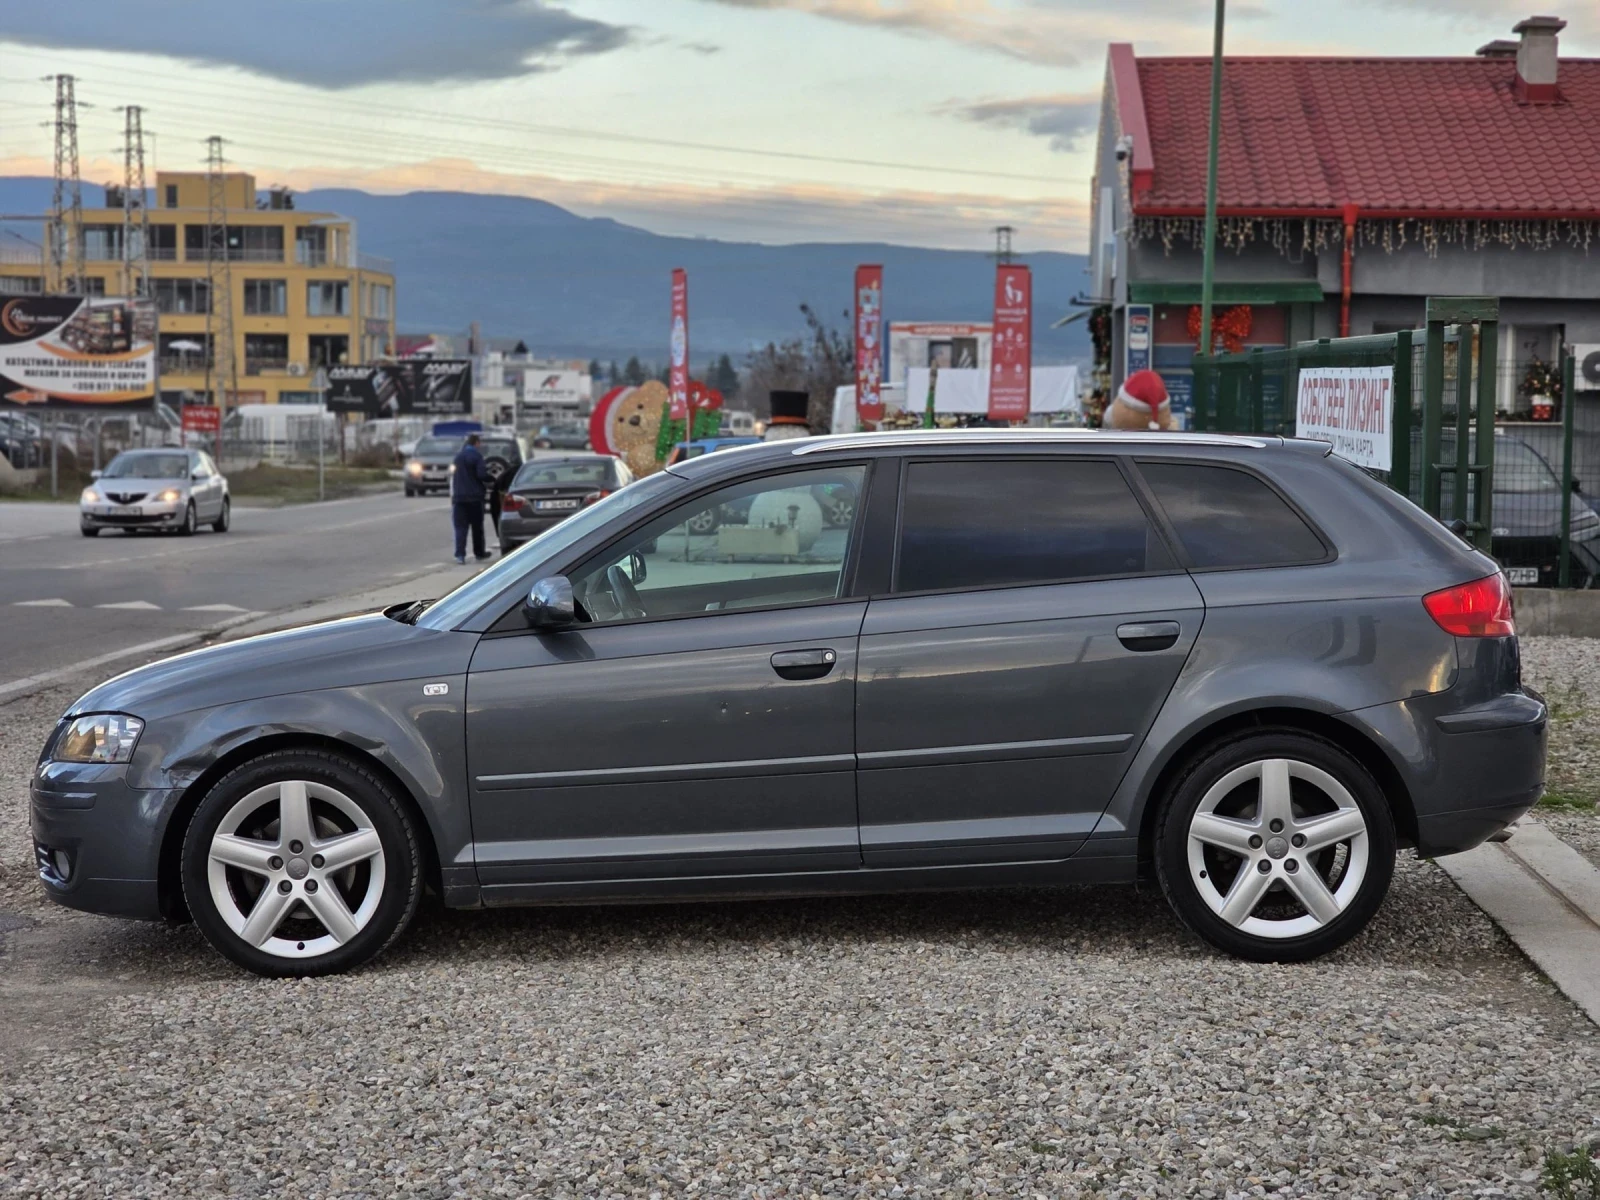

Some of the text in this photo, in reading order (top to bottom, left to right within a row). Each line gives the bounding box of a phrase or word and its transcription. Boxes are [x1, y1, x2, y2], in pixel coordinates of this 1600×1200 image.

[1301, 377, 1390, 435] СОБСТВЕН ЛИЗИНГ
[1356, 438, 1374, 458] КАРТА
